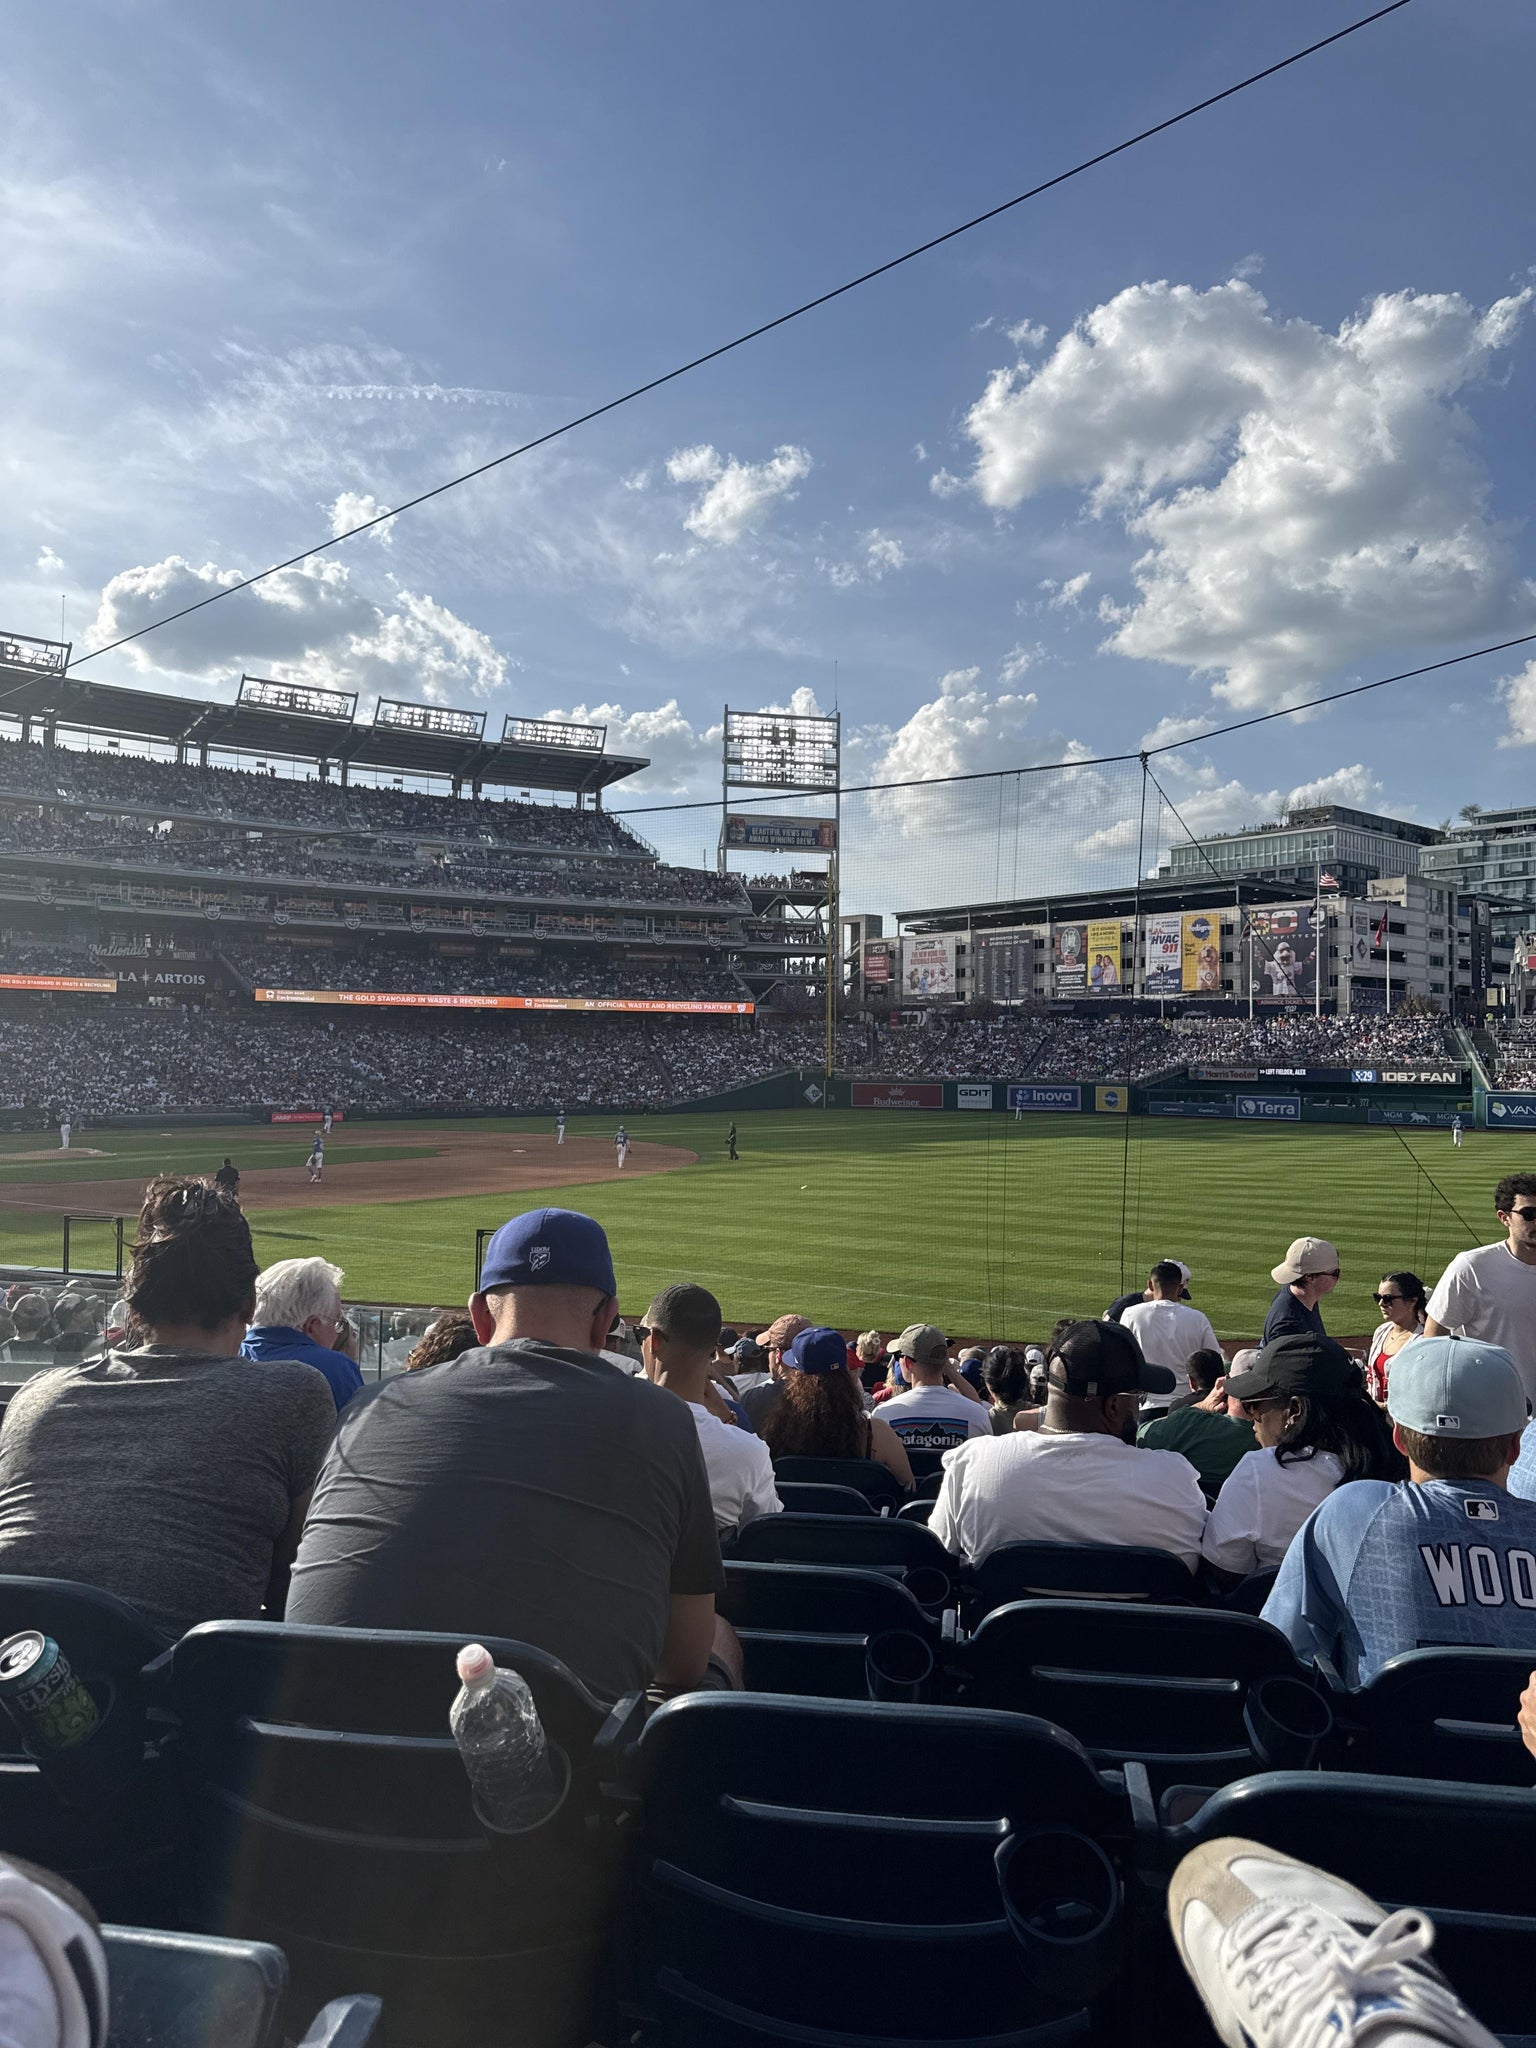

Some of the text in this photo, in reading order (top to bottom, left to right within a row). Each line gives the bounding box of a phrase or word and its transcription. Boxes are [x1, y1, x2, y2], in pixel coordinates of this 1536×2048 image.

[751, 828, 781, 837] BEAUTIFUL
[781, 829, 800, 837] VIEWS
[801, 829, 813, 838] AND
[749, 835, 769, 844] AWARD
[770, 836, 795, 845] WINNING
[1151, 934, 1180, 944] HVAC
[88, 943, 149, 958] Nationals
[1162, 943, 1178, 953] 911
[154, 973, 206, 985] ARTOIS
[355, 994, 375, 1002] GOLD
[377, 995, 417, 1003] STANDARD
[1205, 1070, 1256, 1080] Harris Teeter
[1275, 1069, 1294, 1077] FIELDER,
[1355, 1071, 1373, 1081] 5:29
[1420, 1072, 1456, 1082] FAN
[1032, 1089, 1072, 1101] Inova
[873, 1097, 920, 1106] Budweiser
[1257, 1101, 1295, 1115] Terra
[1383, 1111, 1403, 1119] MGM
[900, 1434, 964, 1448] atagonia
